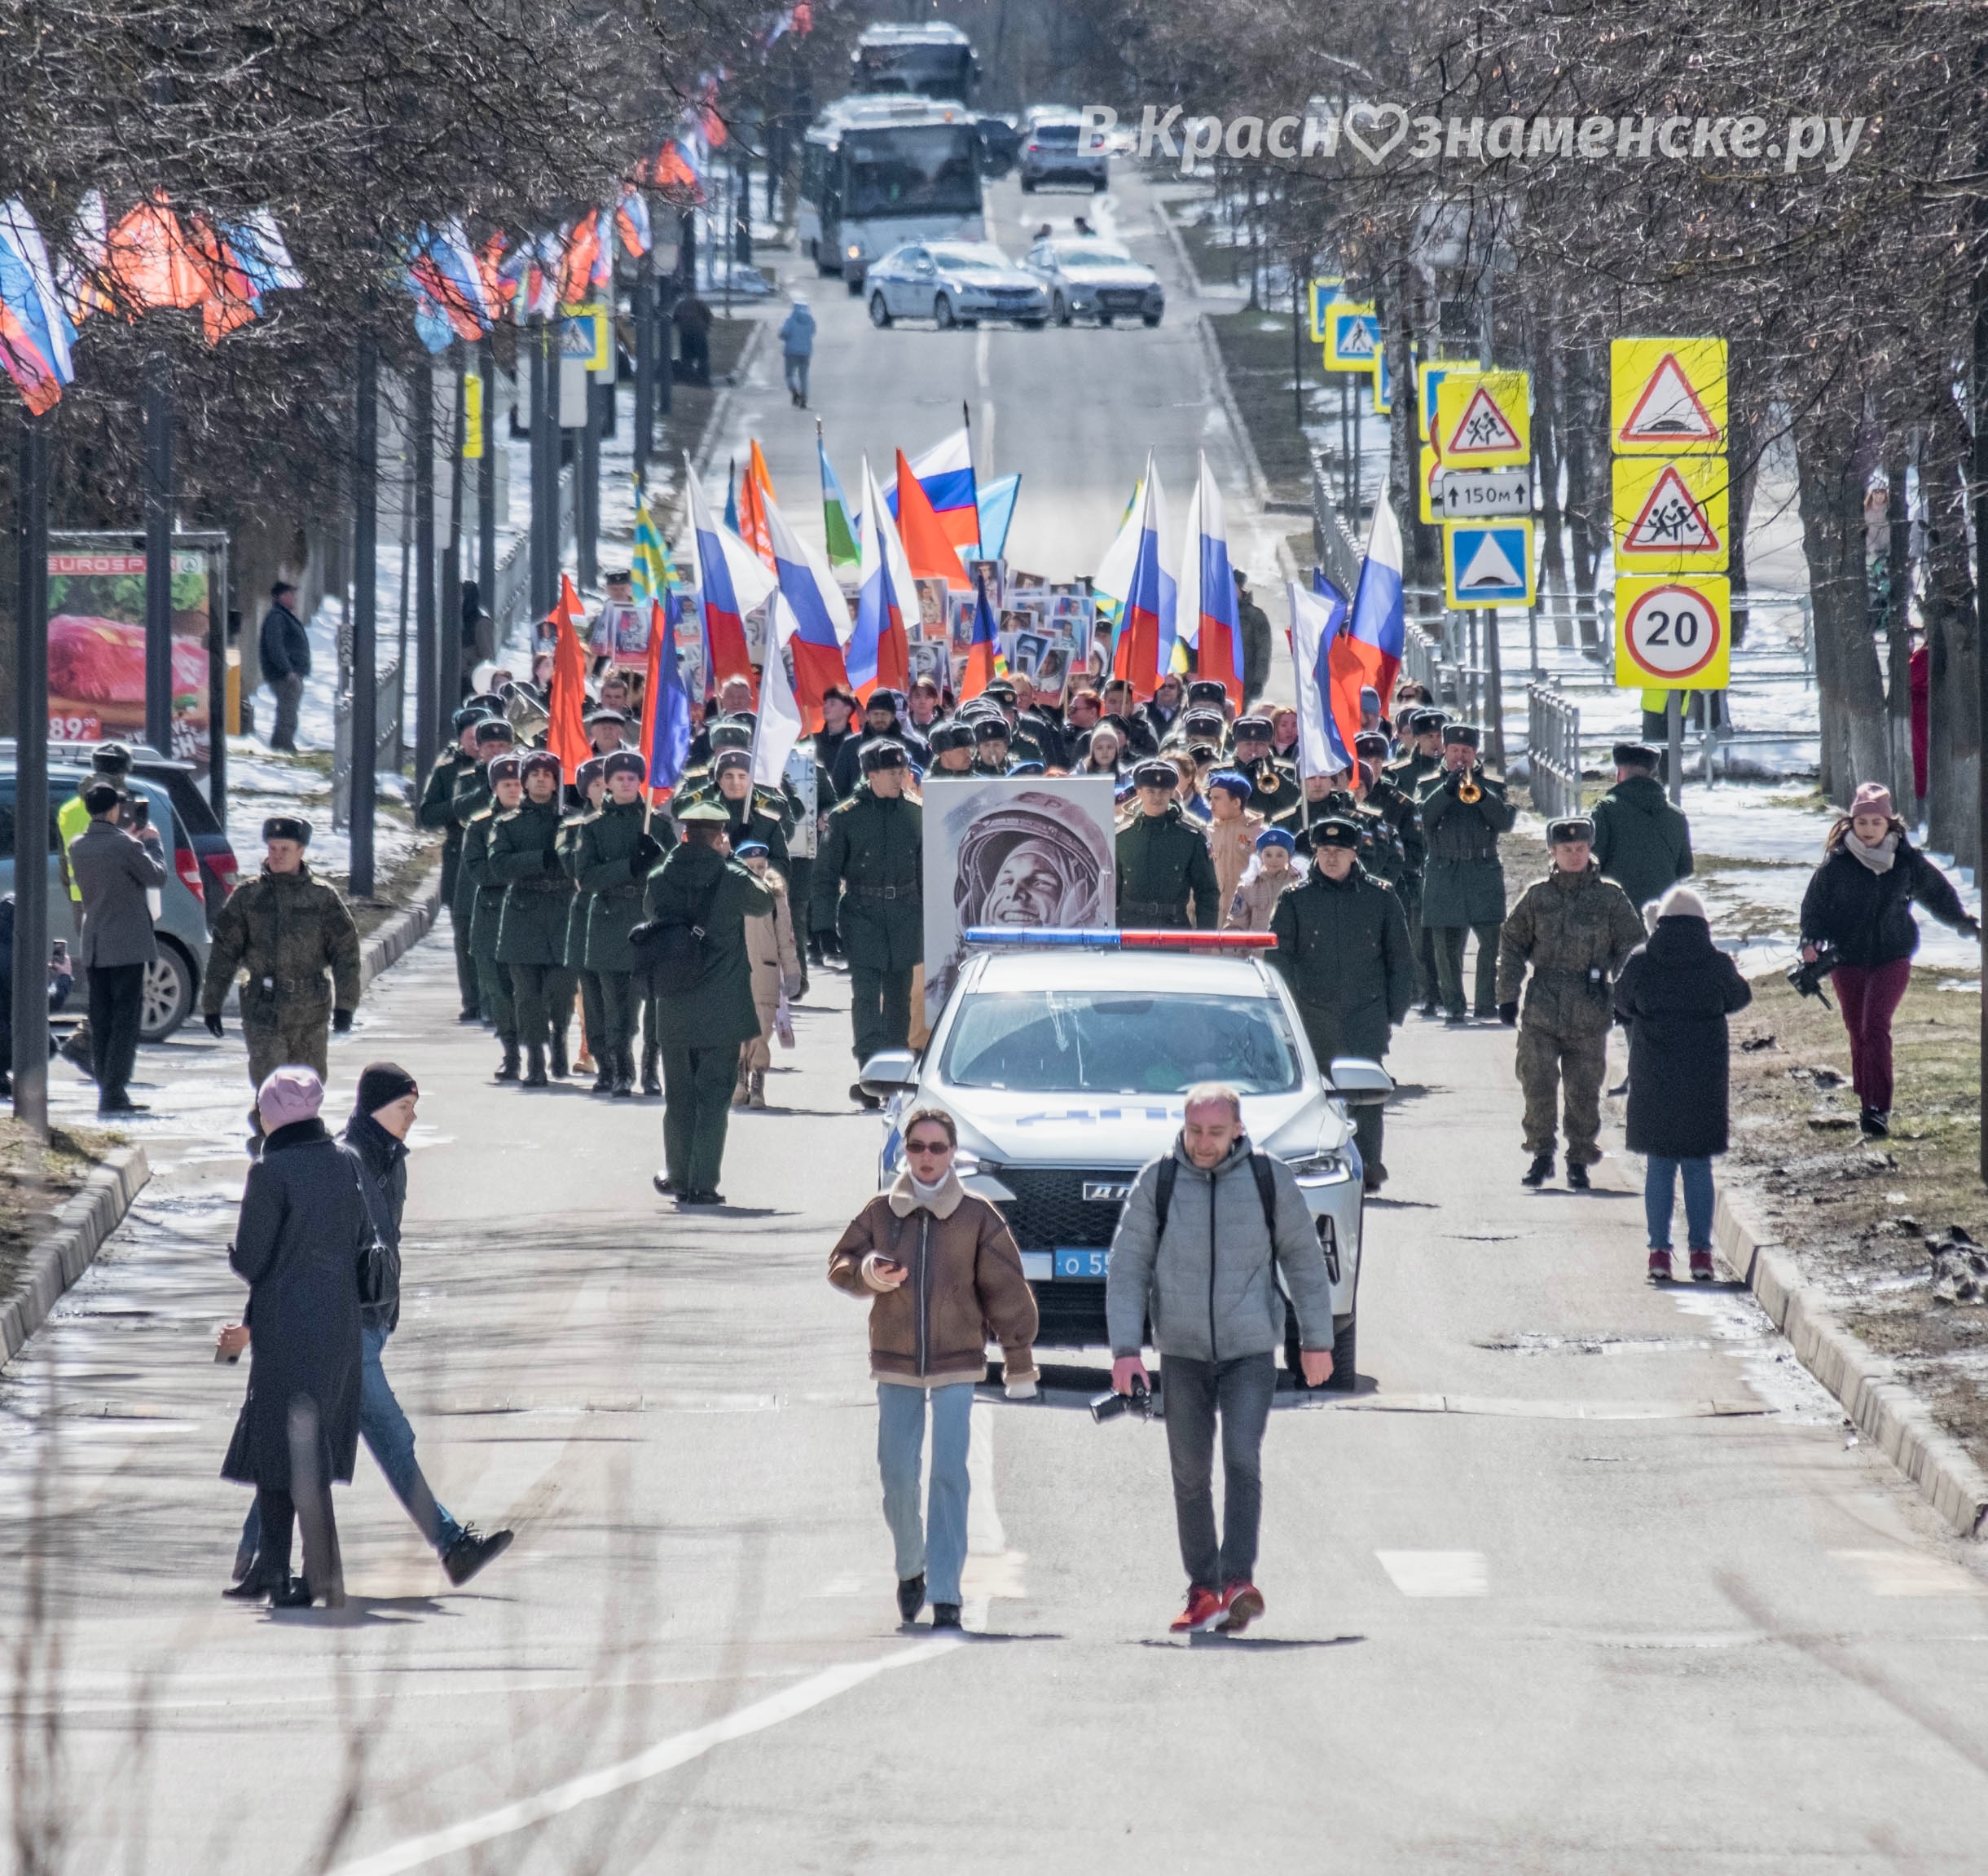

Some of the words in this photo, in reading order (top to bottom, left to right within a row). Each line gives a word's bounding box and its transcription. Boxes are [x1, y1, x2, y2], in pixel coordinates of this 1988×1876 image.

[1465, 487, 1511, 504] 150м
[47, 558, 177, 571] EUROSP
[1645, 610, 1698, 647] 20
[1016, 1107, 1185, 1126] ДП
[1091, 1186, 1133, 1200] ДП
